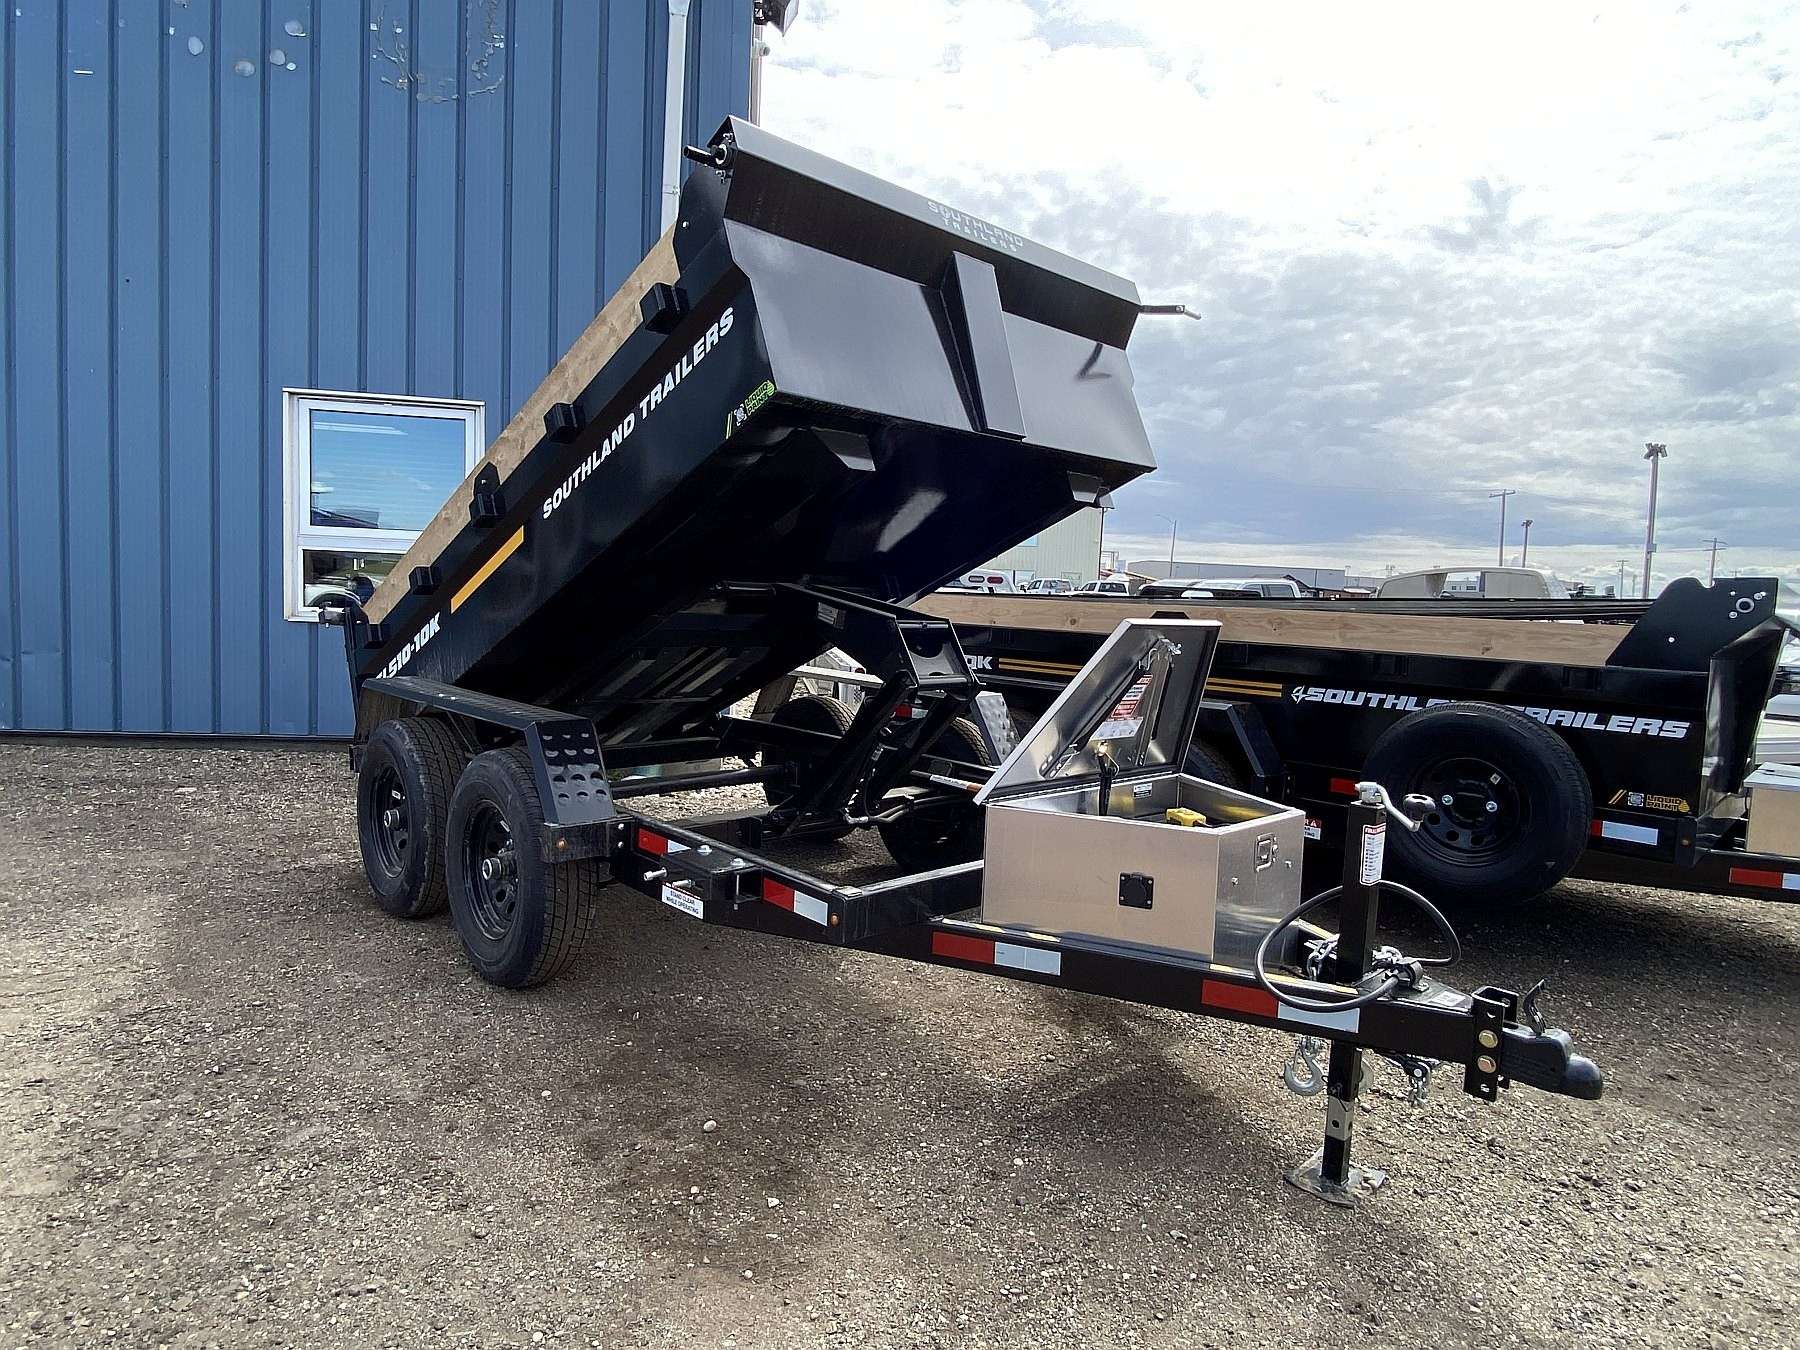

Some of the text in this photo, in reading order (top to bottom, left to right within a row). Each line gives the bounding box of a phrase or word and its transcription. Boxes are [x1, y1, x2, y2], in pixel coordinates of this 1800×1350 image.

[927, 201, 1024, 247] SOUTHLAND
[943, 218, 1018, 252] TRAILERS
[542, 307, 735, 520] SOUTHLAND TRAILERS
[376, 612, 440, 678] 510-10K
[1306, 687, 1691, 740] SOUTHL RAILERS
[1646, 795, 1682, 805] LIQUID
[1646, 801, 1678, 811] PAINT
